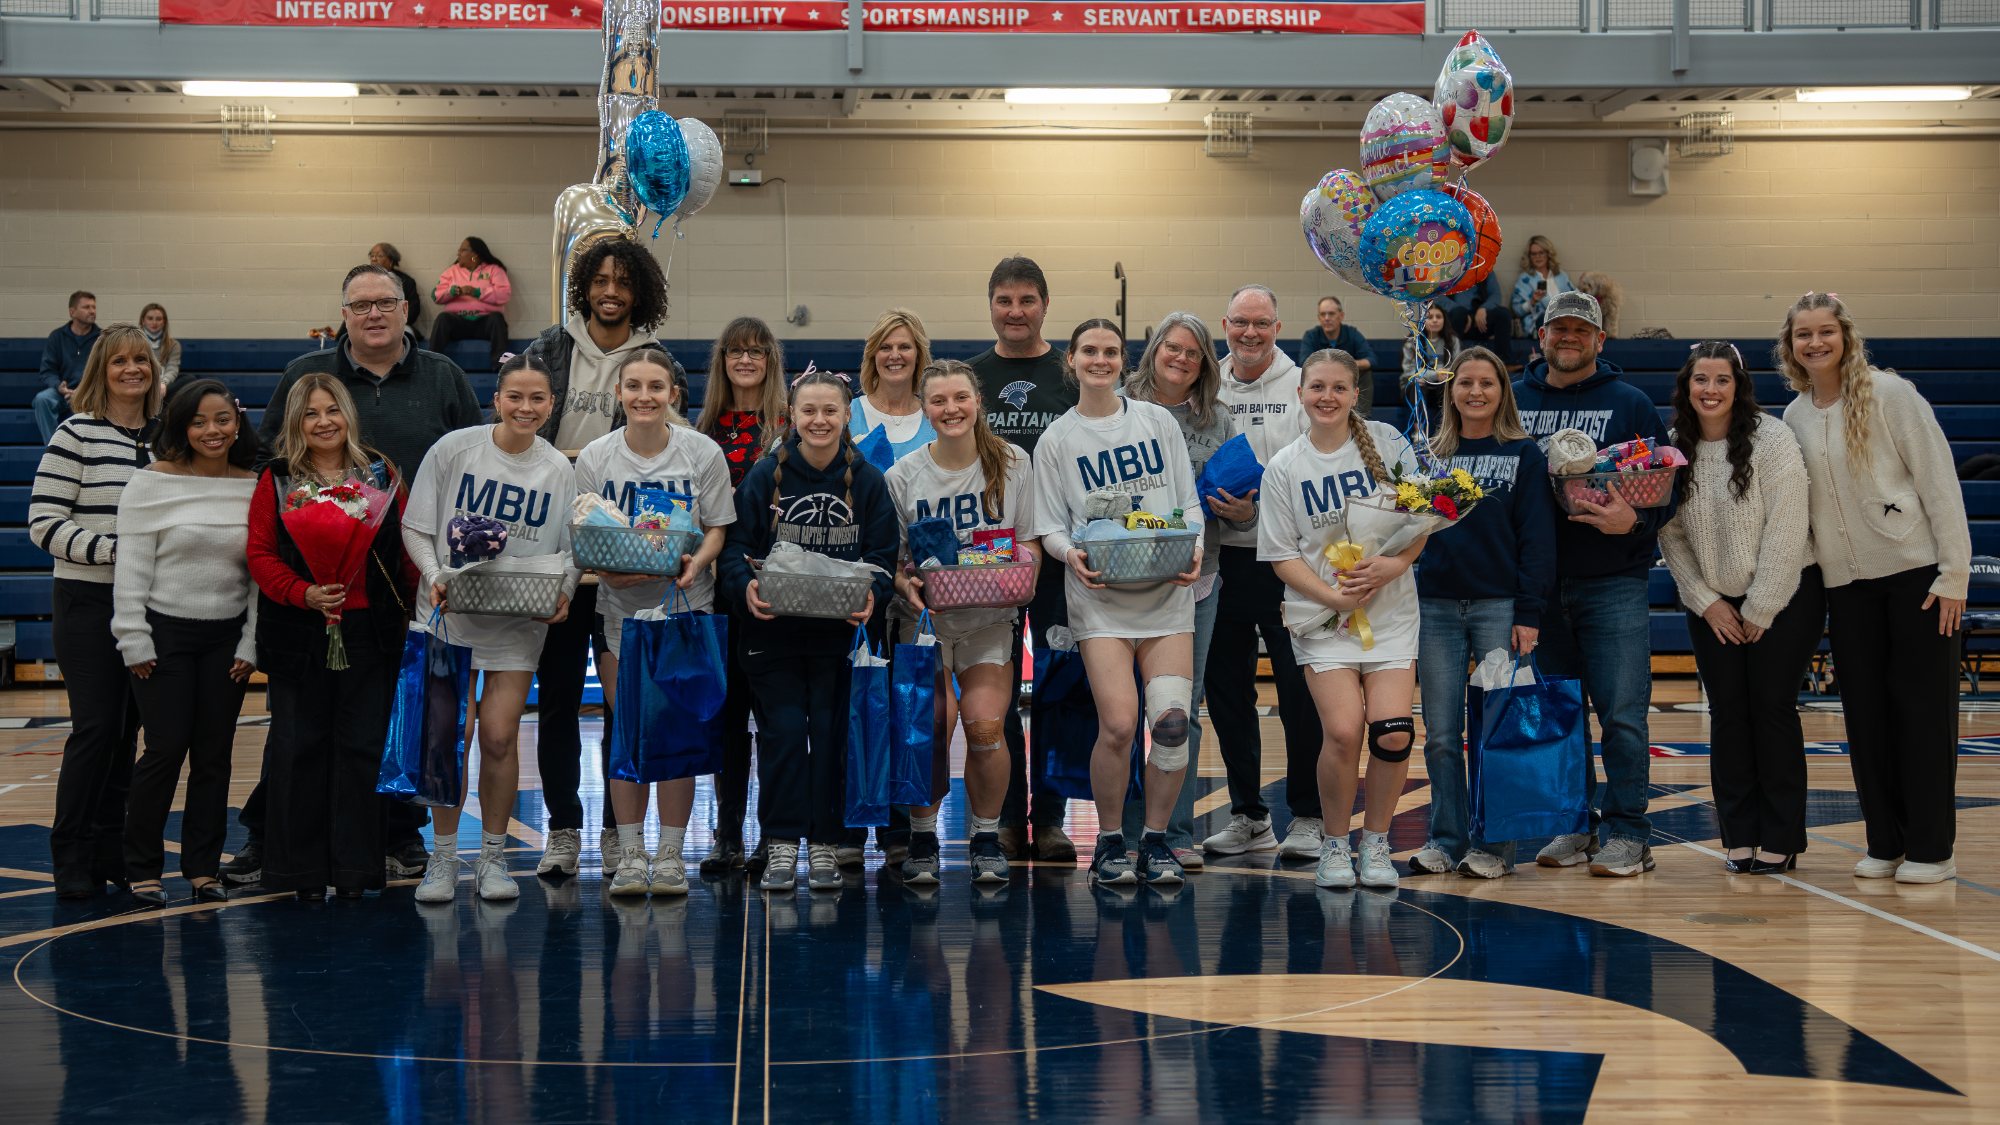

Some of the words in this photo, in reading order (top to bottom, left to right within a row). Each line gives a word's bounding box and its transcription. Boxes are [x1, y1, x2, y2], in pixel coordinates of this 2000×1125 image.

[276, 1, 393, 19] INTEGRITY
[450, 3, 549, 21] RESPECT
[1083, 9, 1180, 26] SERVANT
[1187, 9, 1322, 26] LEADERSHIP
[1398, 239, 1460, 266] GOOD
[1402, 264, 1454, 283] LUCK
[982, 411, 1061, 428] PARTAN
[1557, 409, 1614, 442] BAPTIST
[1076, 438, 1165, 492] MBU
[1472, 454, 1521, 486] BAPTIST
[455, 472, 552, 528] MBU
